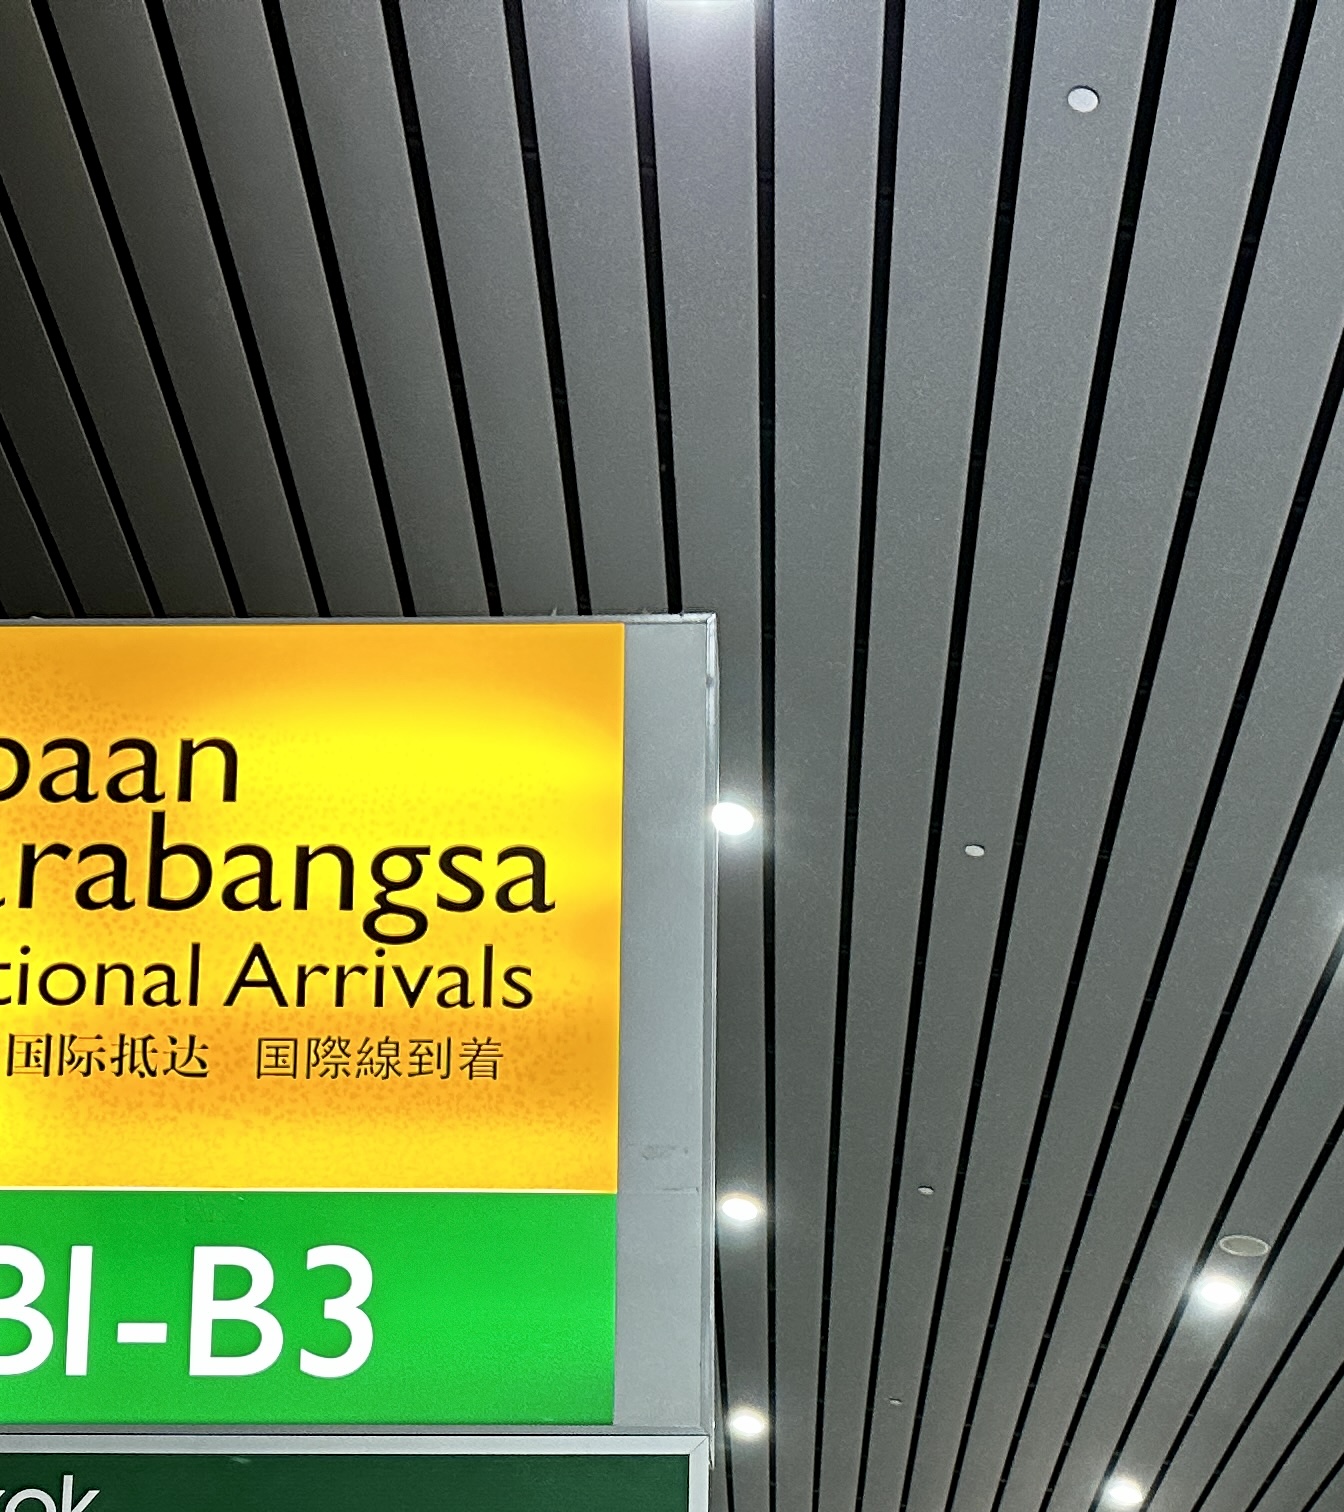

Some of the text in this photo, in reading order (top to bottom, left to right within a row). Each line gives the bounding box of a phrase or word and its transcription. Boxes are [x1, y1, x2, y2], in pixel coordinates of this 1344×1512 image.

[223, 942, 535, 1010] Arrivals
[6, 1032, 210, 1079] 国际抵达
[255, 1034, 505, 1081] 国際線到着
